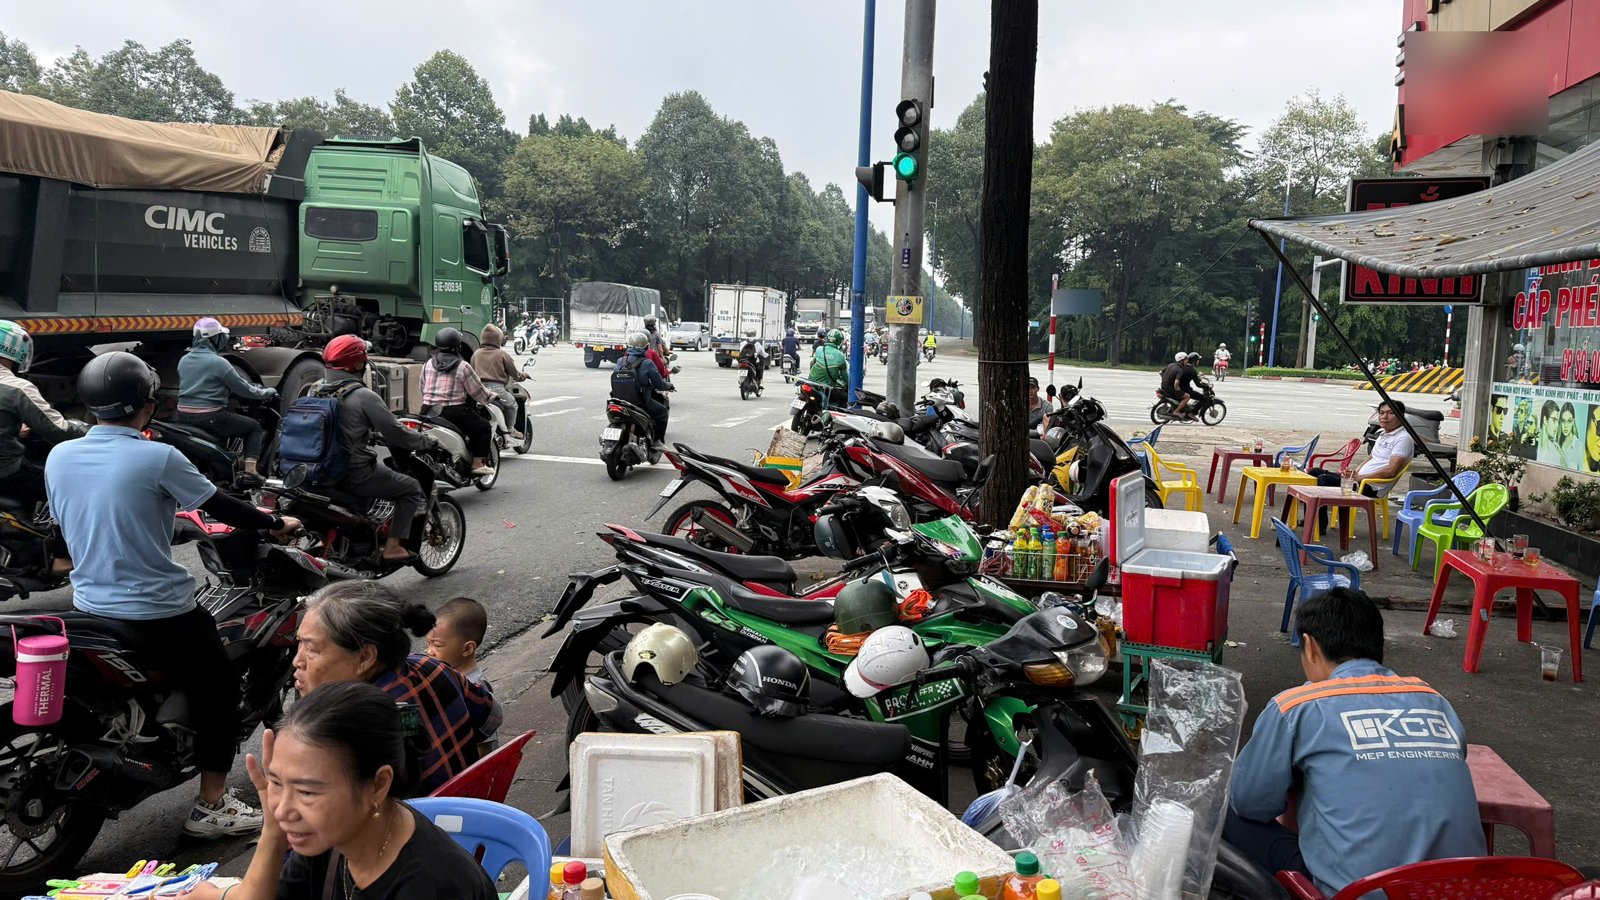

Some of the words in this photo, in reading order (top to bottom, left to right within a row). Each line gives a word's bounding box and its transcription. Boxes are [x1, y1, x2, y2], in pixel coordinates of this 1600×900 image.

[144, 205, 226, 235] CIMC
[183, 233, 238, 251] VEHICLES
[1512, 278, 1552, 331] CẤP
[1554, 273, 1600, 329] PHÉ
[1560, 347, 1574, 381] GP
[38, 667, 52, 717] THERMAL
[762, 676, 798, 690] HONDA
[1355, 752, 1385, 761] MEP
[1388, 749, 1464, 760] ENGINEERIN
